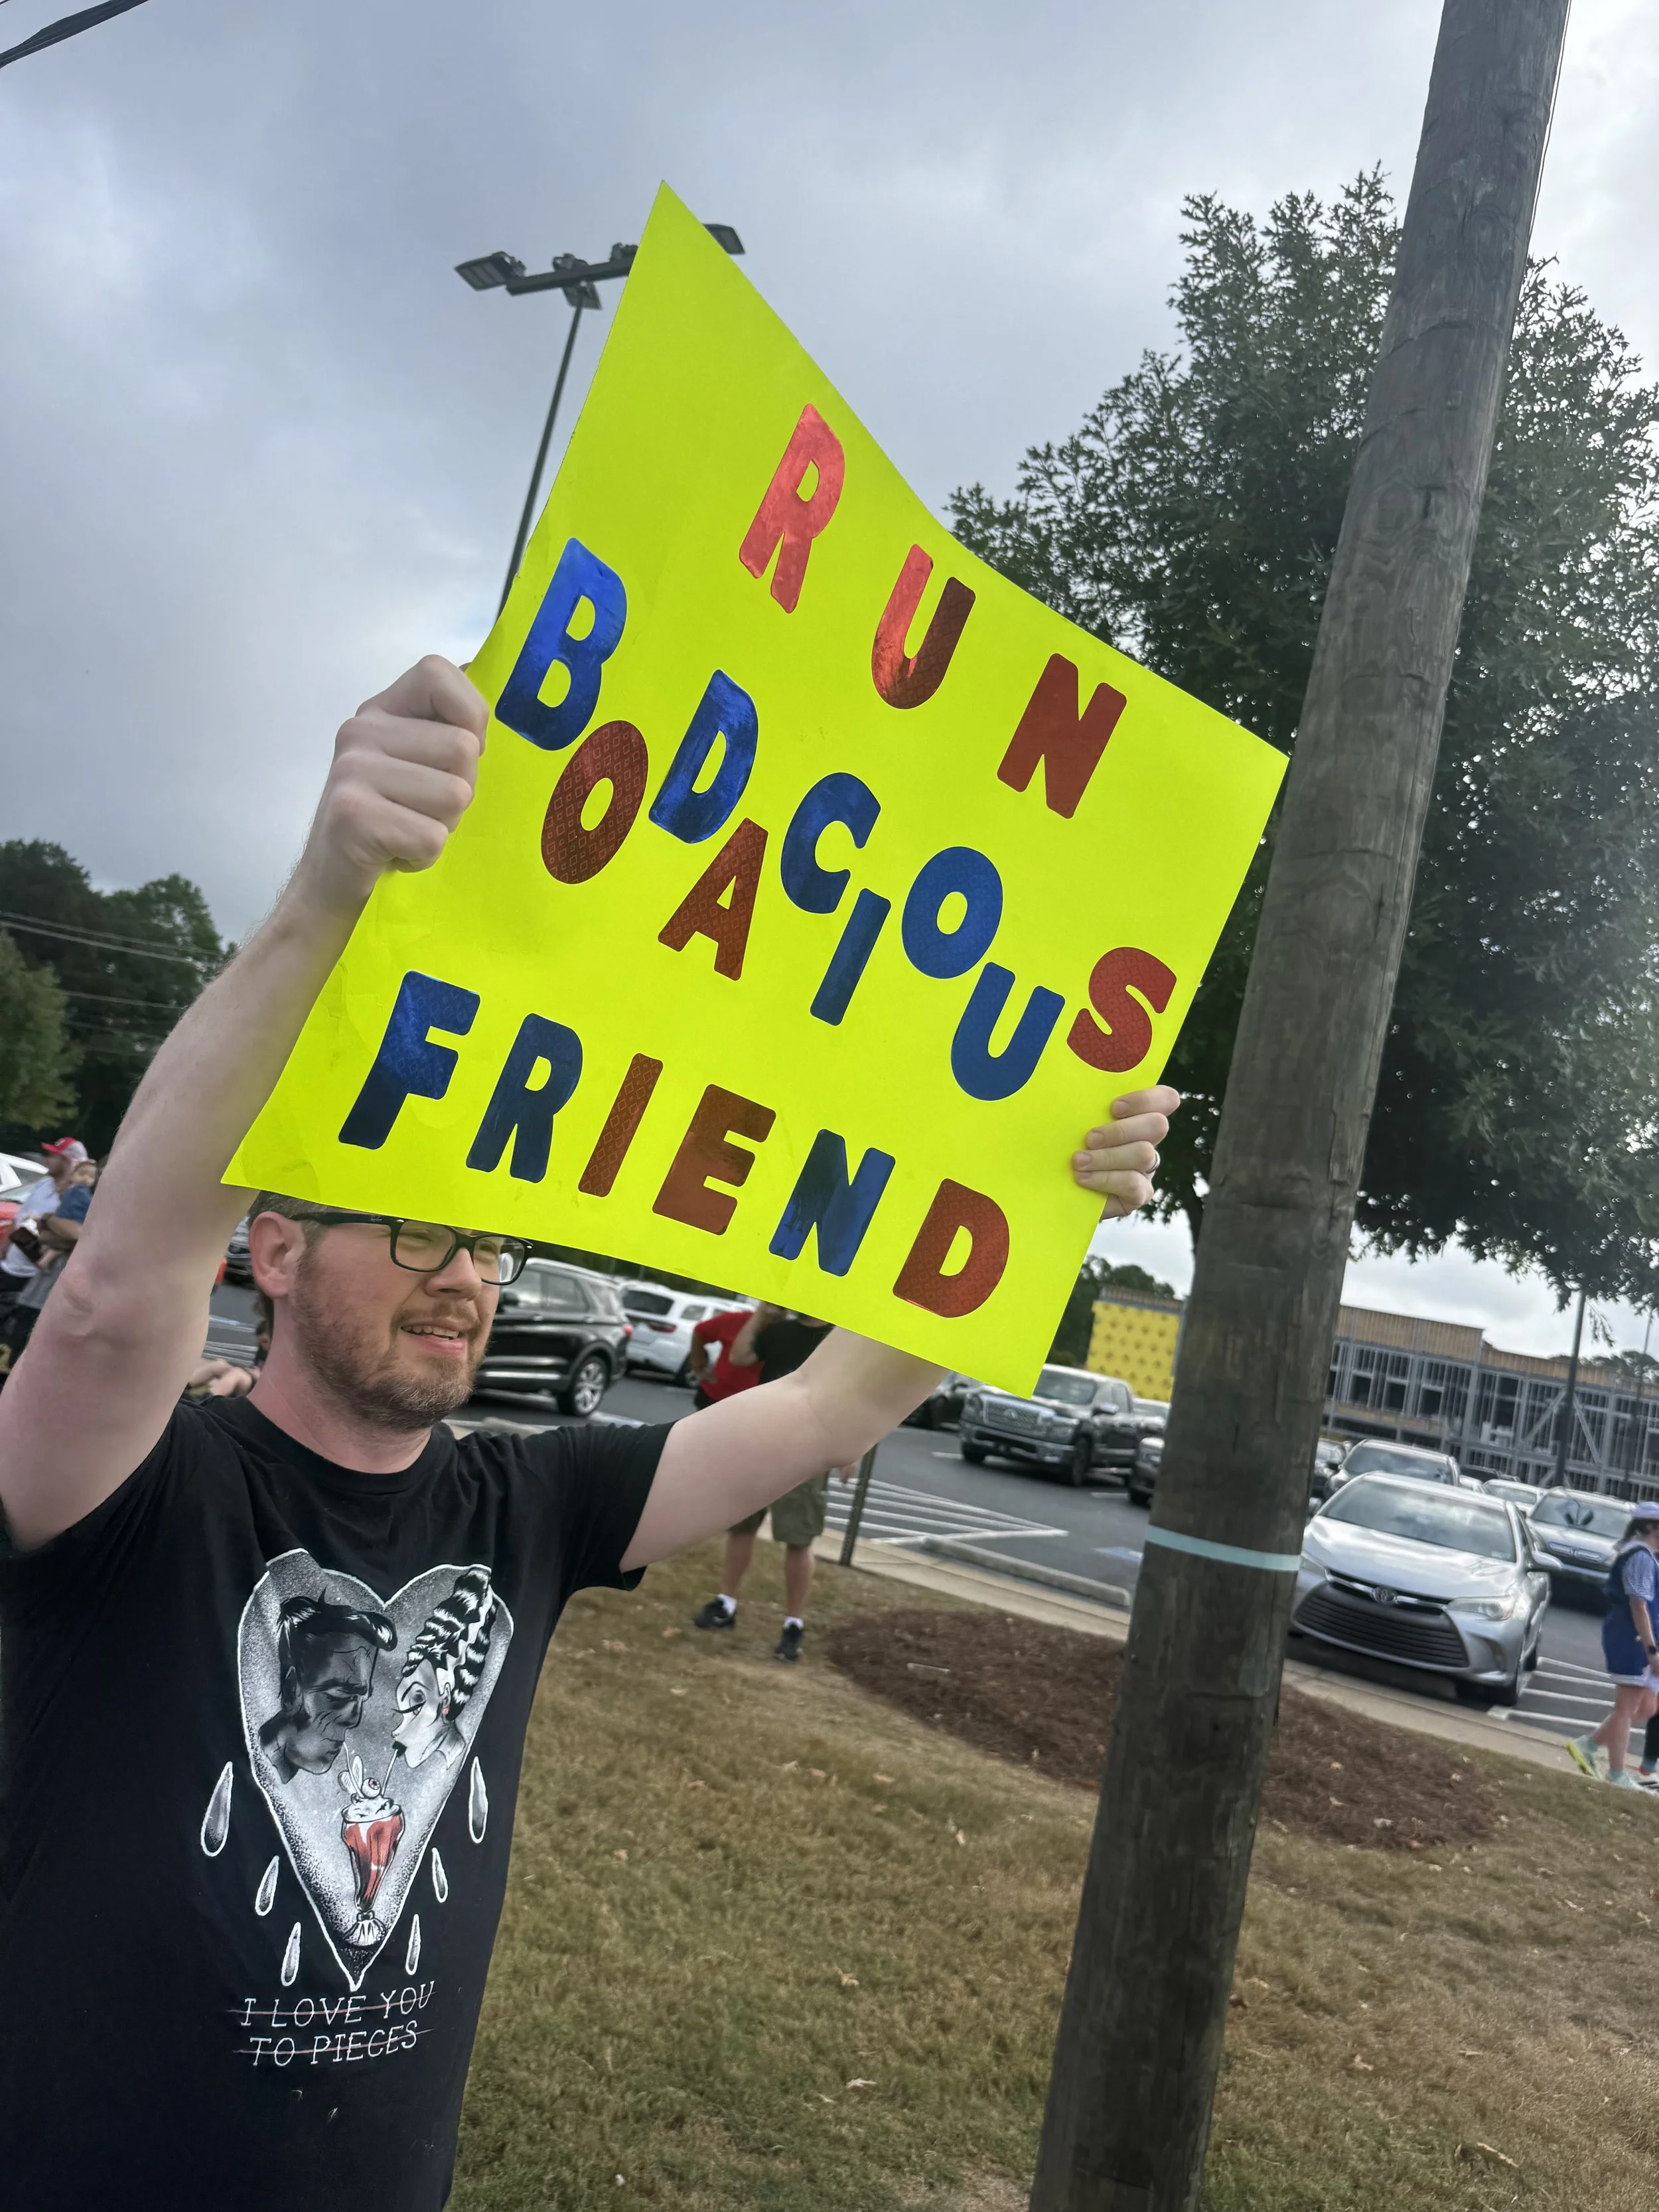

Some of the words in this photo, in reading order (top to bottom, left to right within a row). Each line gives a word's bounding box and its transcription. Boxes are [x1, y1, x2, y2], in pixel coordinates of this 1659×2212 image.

[739, 403, 1127, 819] RUN
[494, 537, 1177, 1102] BODACIOUS
[338, 970, 1010, 1317] FRIEND
[240, 1998, 257, 2026] I
[271, 1995, 366, 2028] LOVE
[380, 1980, 435, 2019] YOU
[250, 2037, 295, 2067] TO
[310, 2020, 418, 2065] PIECES
